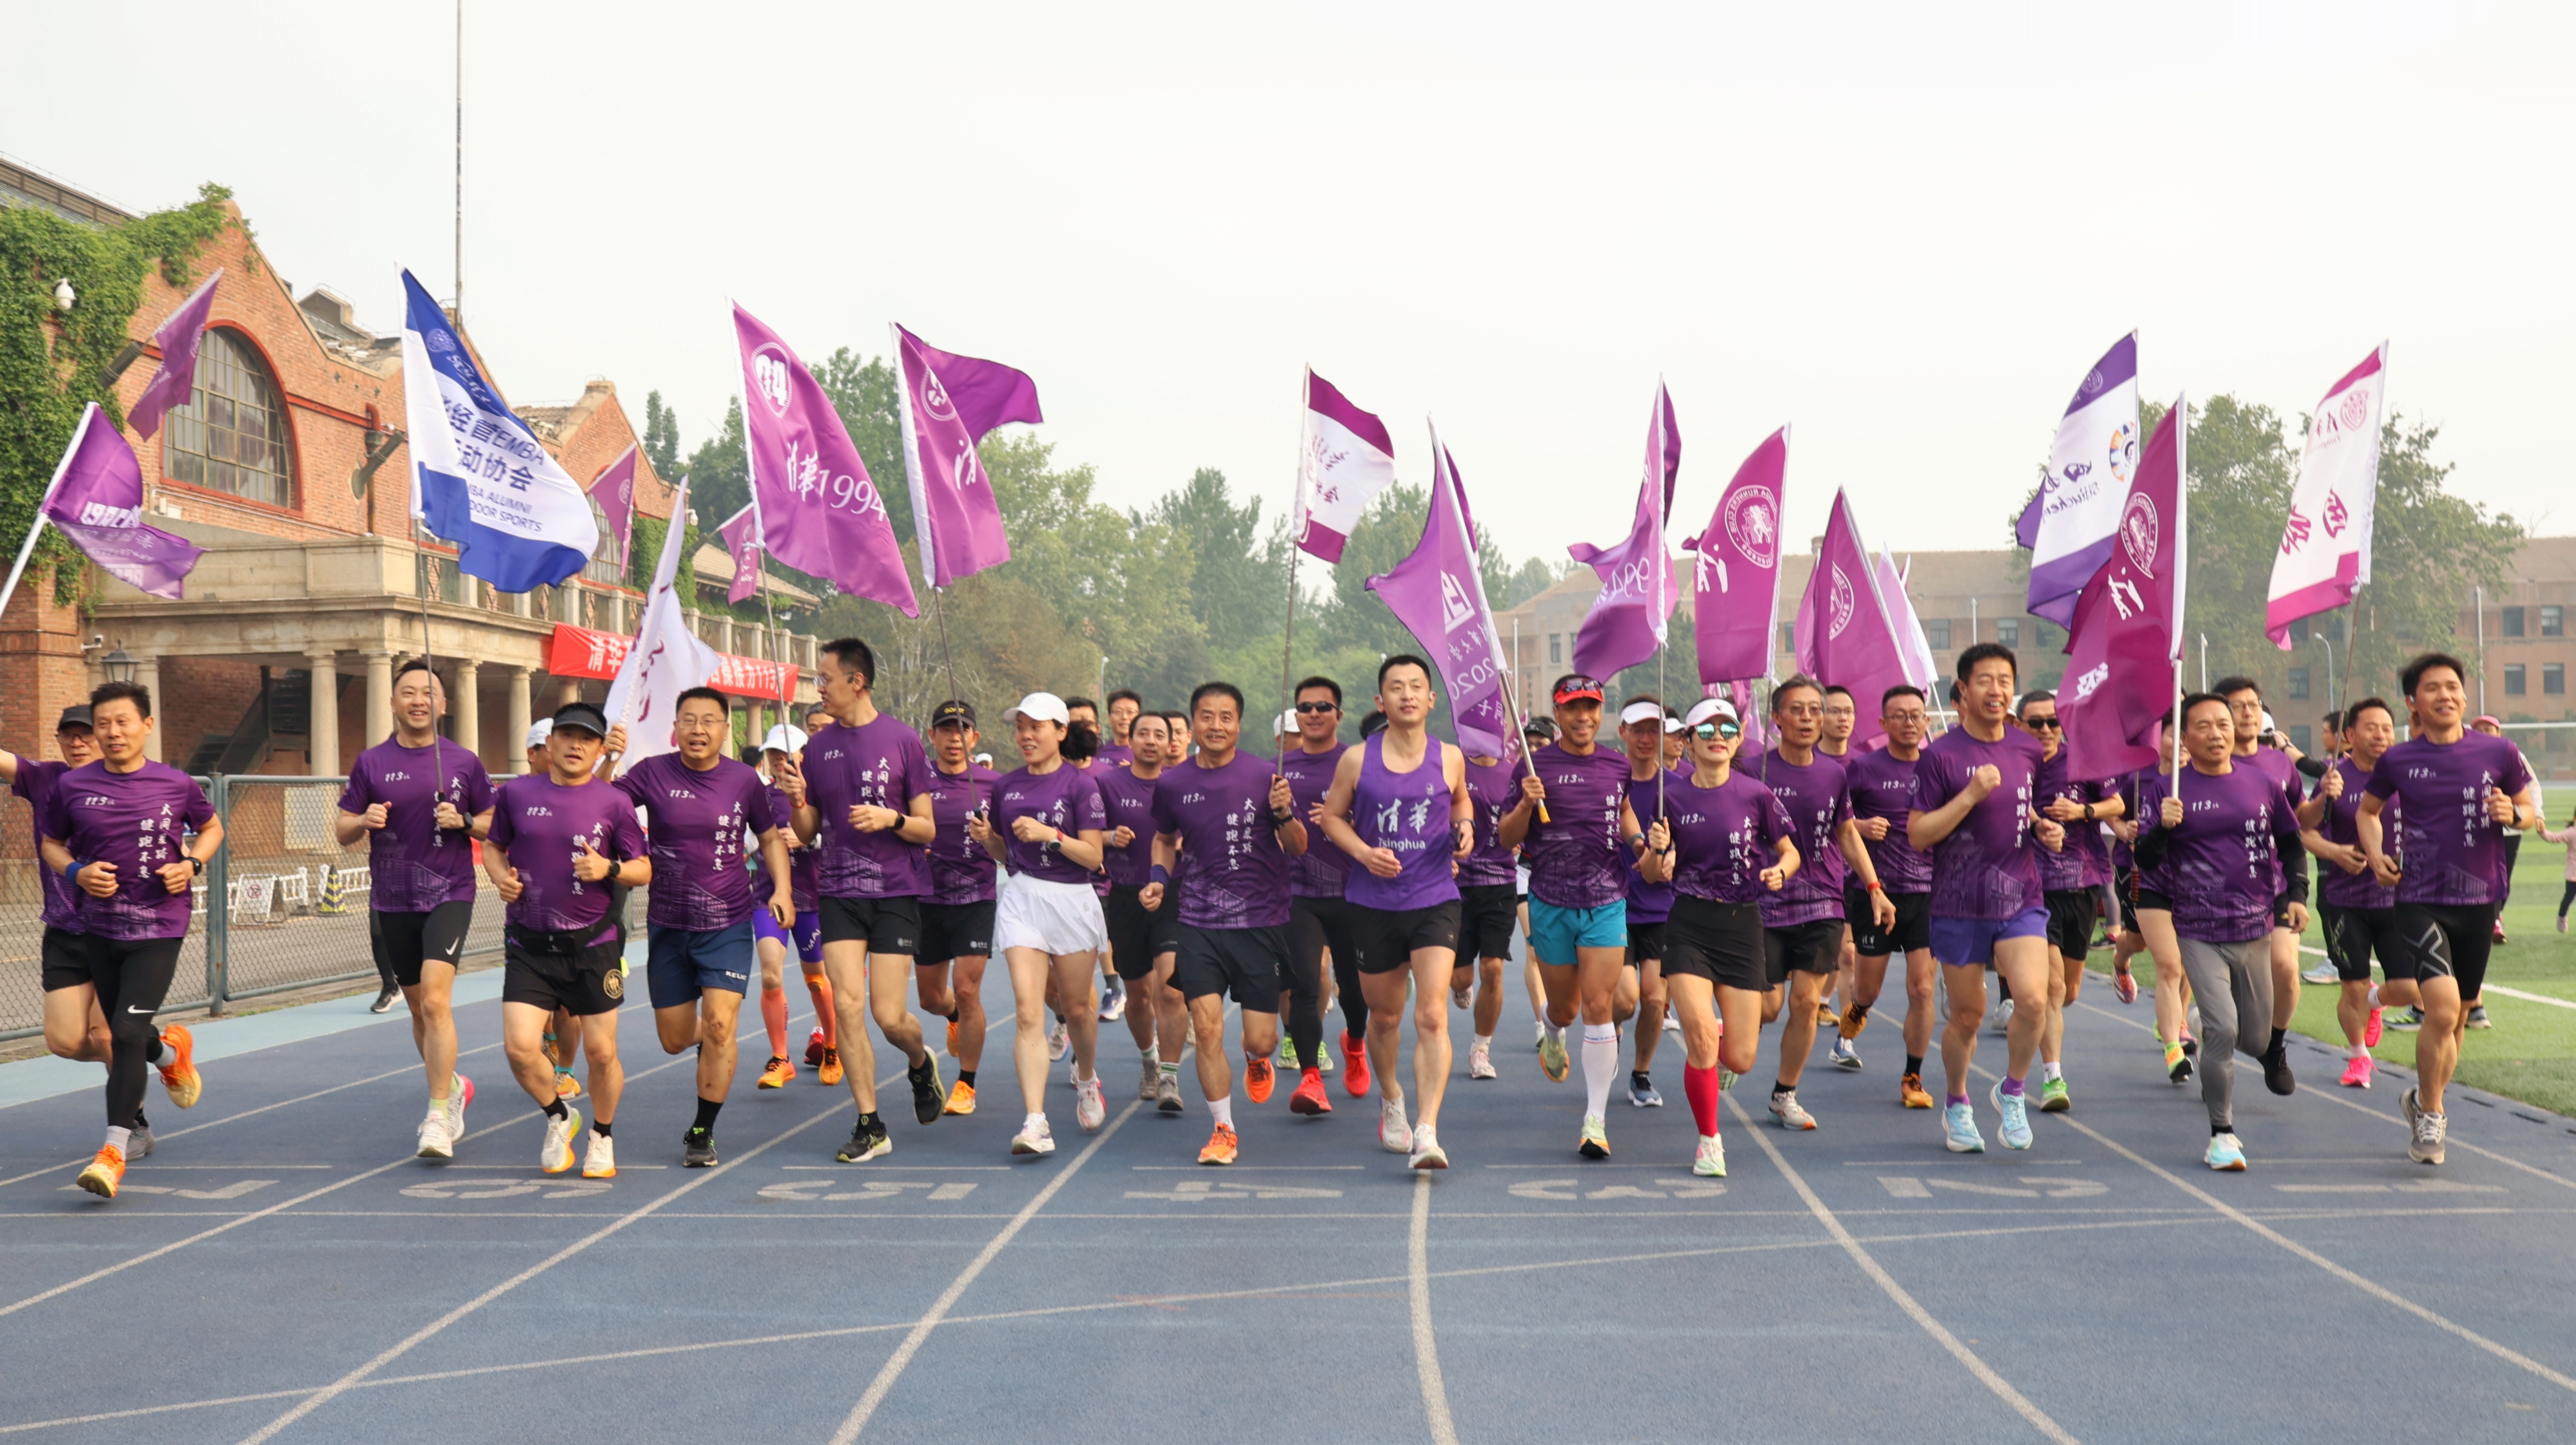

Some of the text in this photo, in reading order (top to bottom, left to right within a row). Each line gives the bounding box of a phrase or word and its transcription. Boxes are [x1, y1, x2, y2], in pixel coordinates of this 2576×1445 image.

[488, 491, 533, 515] ALUMNI
[499, 510, 543, 533] SPORTS
[713, 814, 730, 871] 健跑不息
[1226, 813, 1239, 870] 健跑不息
[1377, 798, 1431, 834] 清华
[1605, 795, 1617, 850] 健跑不息
[2015, 786, 2027, 848] 健跑不息
[2462, 785, 2477, 848] 健跑不息
[138, 818, 156, 878] 健跑不息
[1378, 837, 1426, 852] Tsinghua
[1729, 831, 1743, 885] 健跑不息
